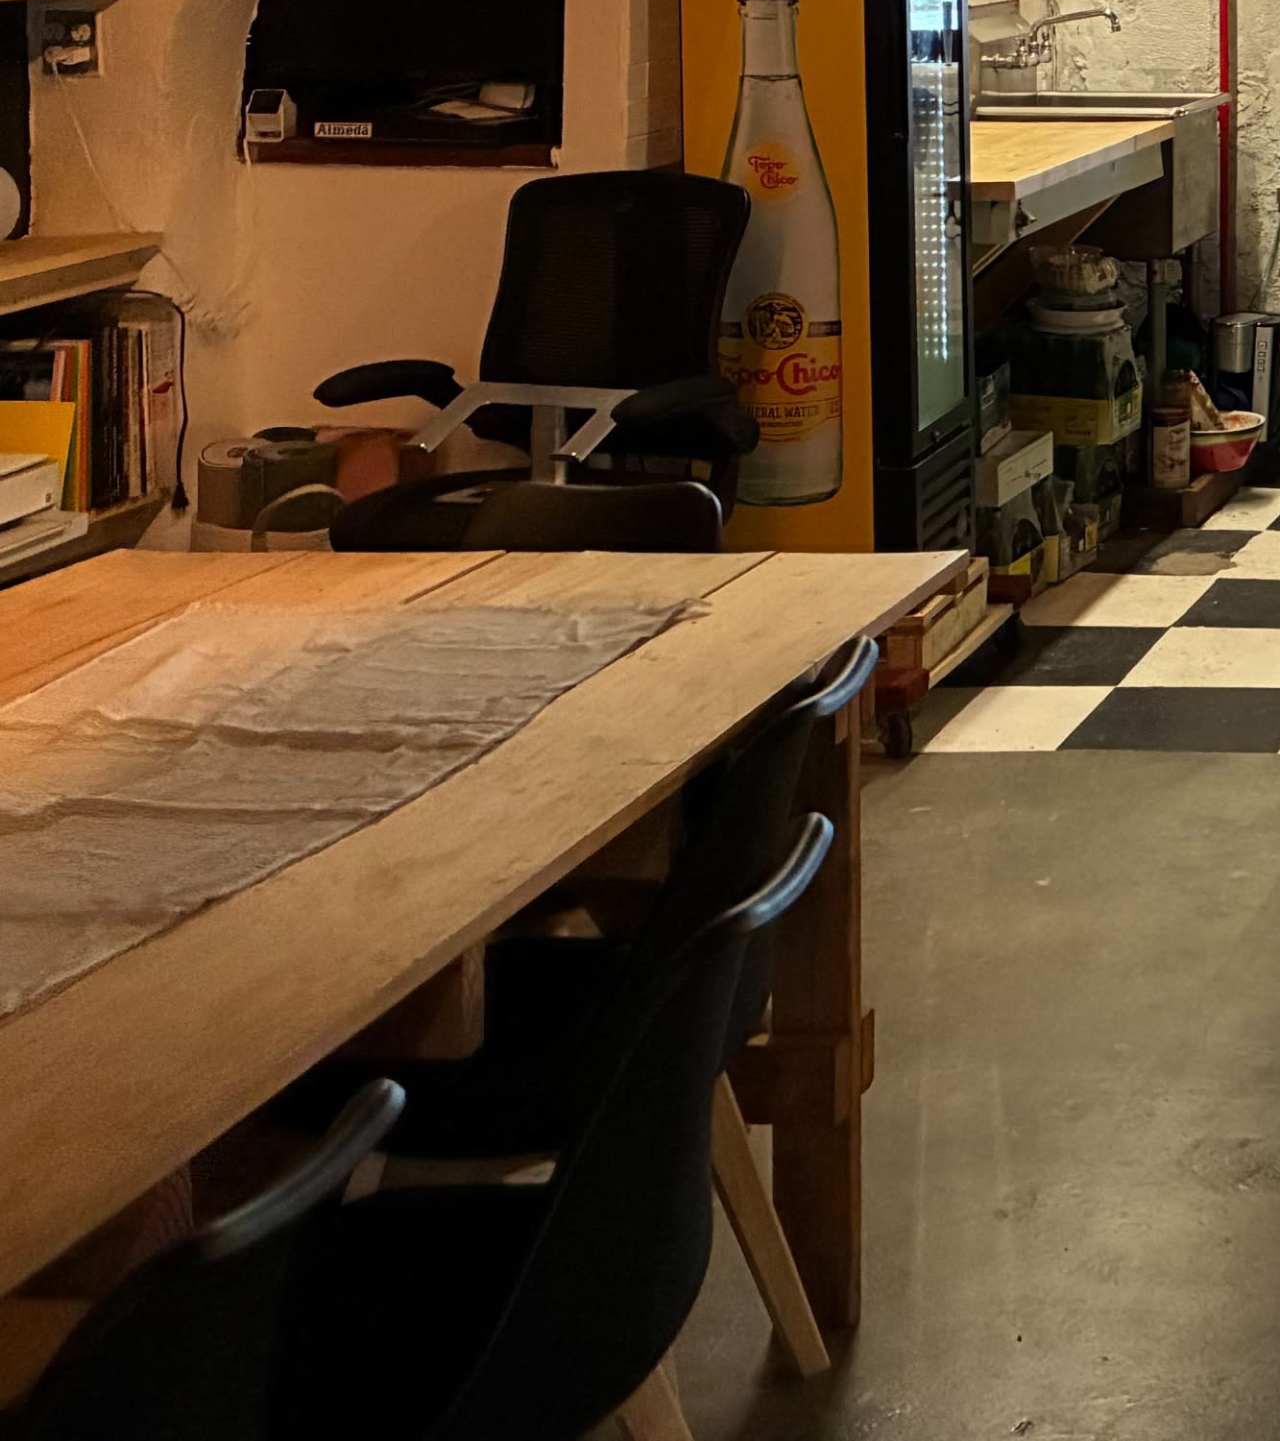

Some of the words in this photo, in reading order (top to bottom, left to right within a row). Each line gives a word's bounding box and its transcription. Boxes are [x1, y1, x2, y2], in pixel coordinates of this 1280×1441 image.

[316, 123, 369, 136] Almeda
[748, 155, 787, 173] Topo
[760, 171, 799, 190] Chico
[775, 352, 841, 396] Chico
